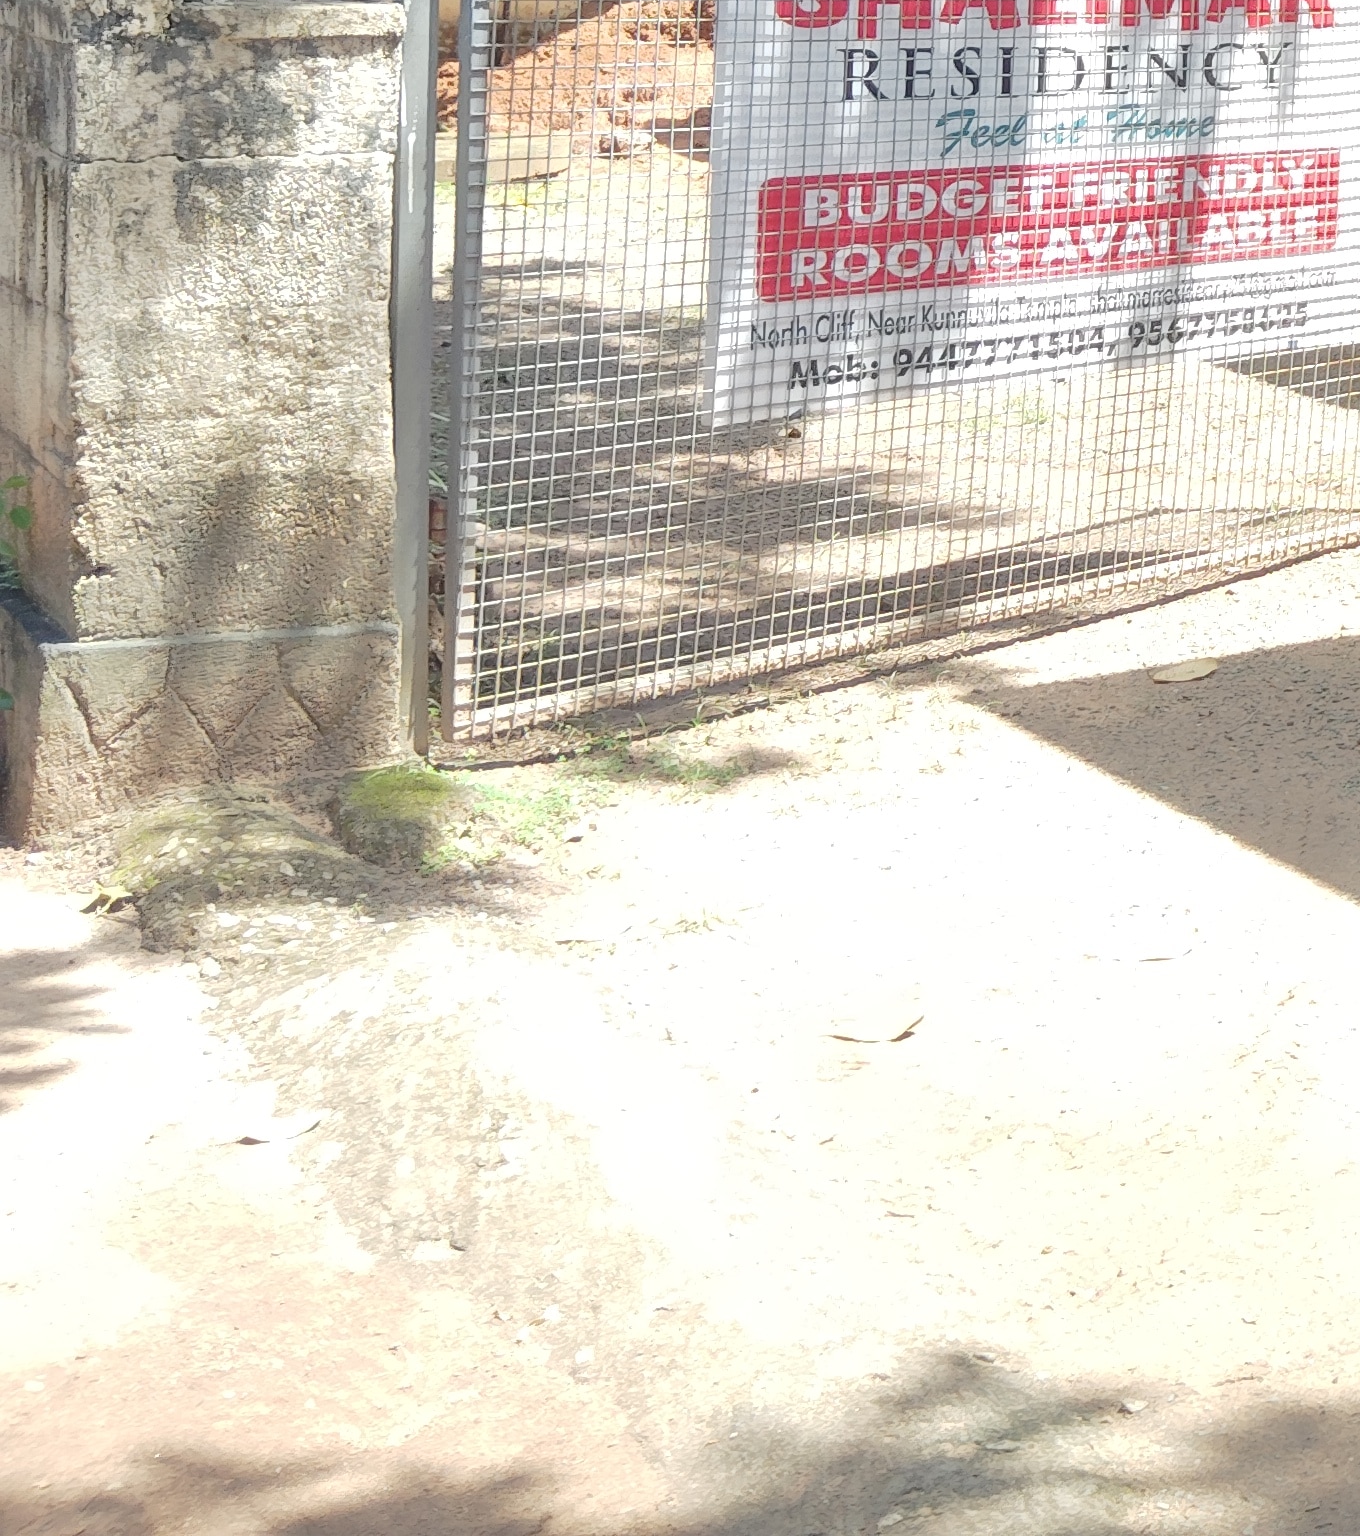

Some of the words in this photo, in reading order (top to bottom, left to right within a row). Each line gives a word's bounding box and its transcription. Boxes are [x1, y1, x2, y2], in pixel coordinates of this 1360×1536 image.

[836, 41, 1294, 102] RESIDENCY
[936, 108, 1027, 158] Feel
[1039, 119, 1088, 144] at
[1107, 103, 1215, 143] Home
[803, 175, 1054, 228] BUDGET
[1072, 158, 1316, 210] FRIENDLY
[791, 232, 1022, 287] ROOMS
[1040, 207, 1319, 263] AVAILABLE
[750, 321, 807, 350] North
[815, 309, 860, 347] Cliff,
[868, 308, 915, 338] Near
[788, 353, 880, 390] Mob:
